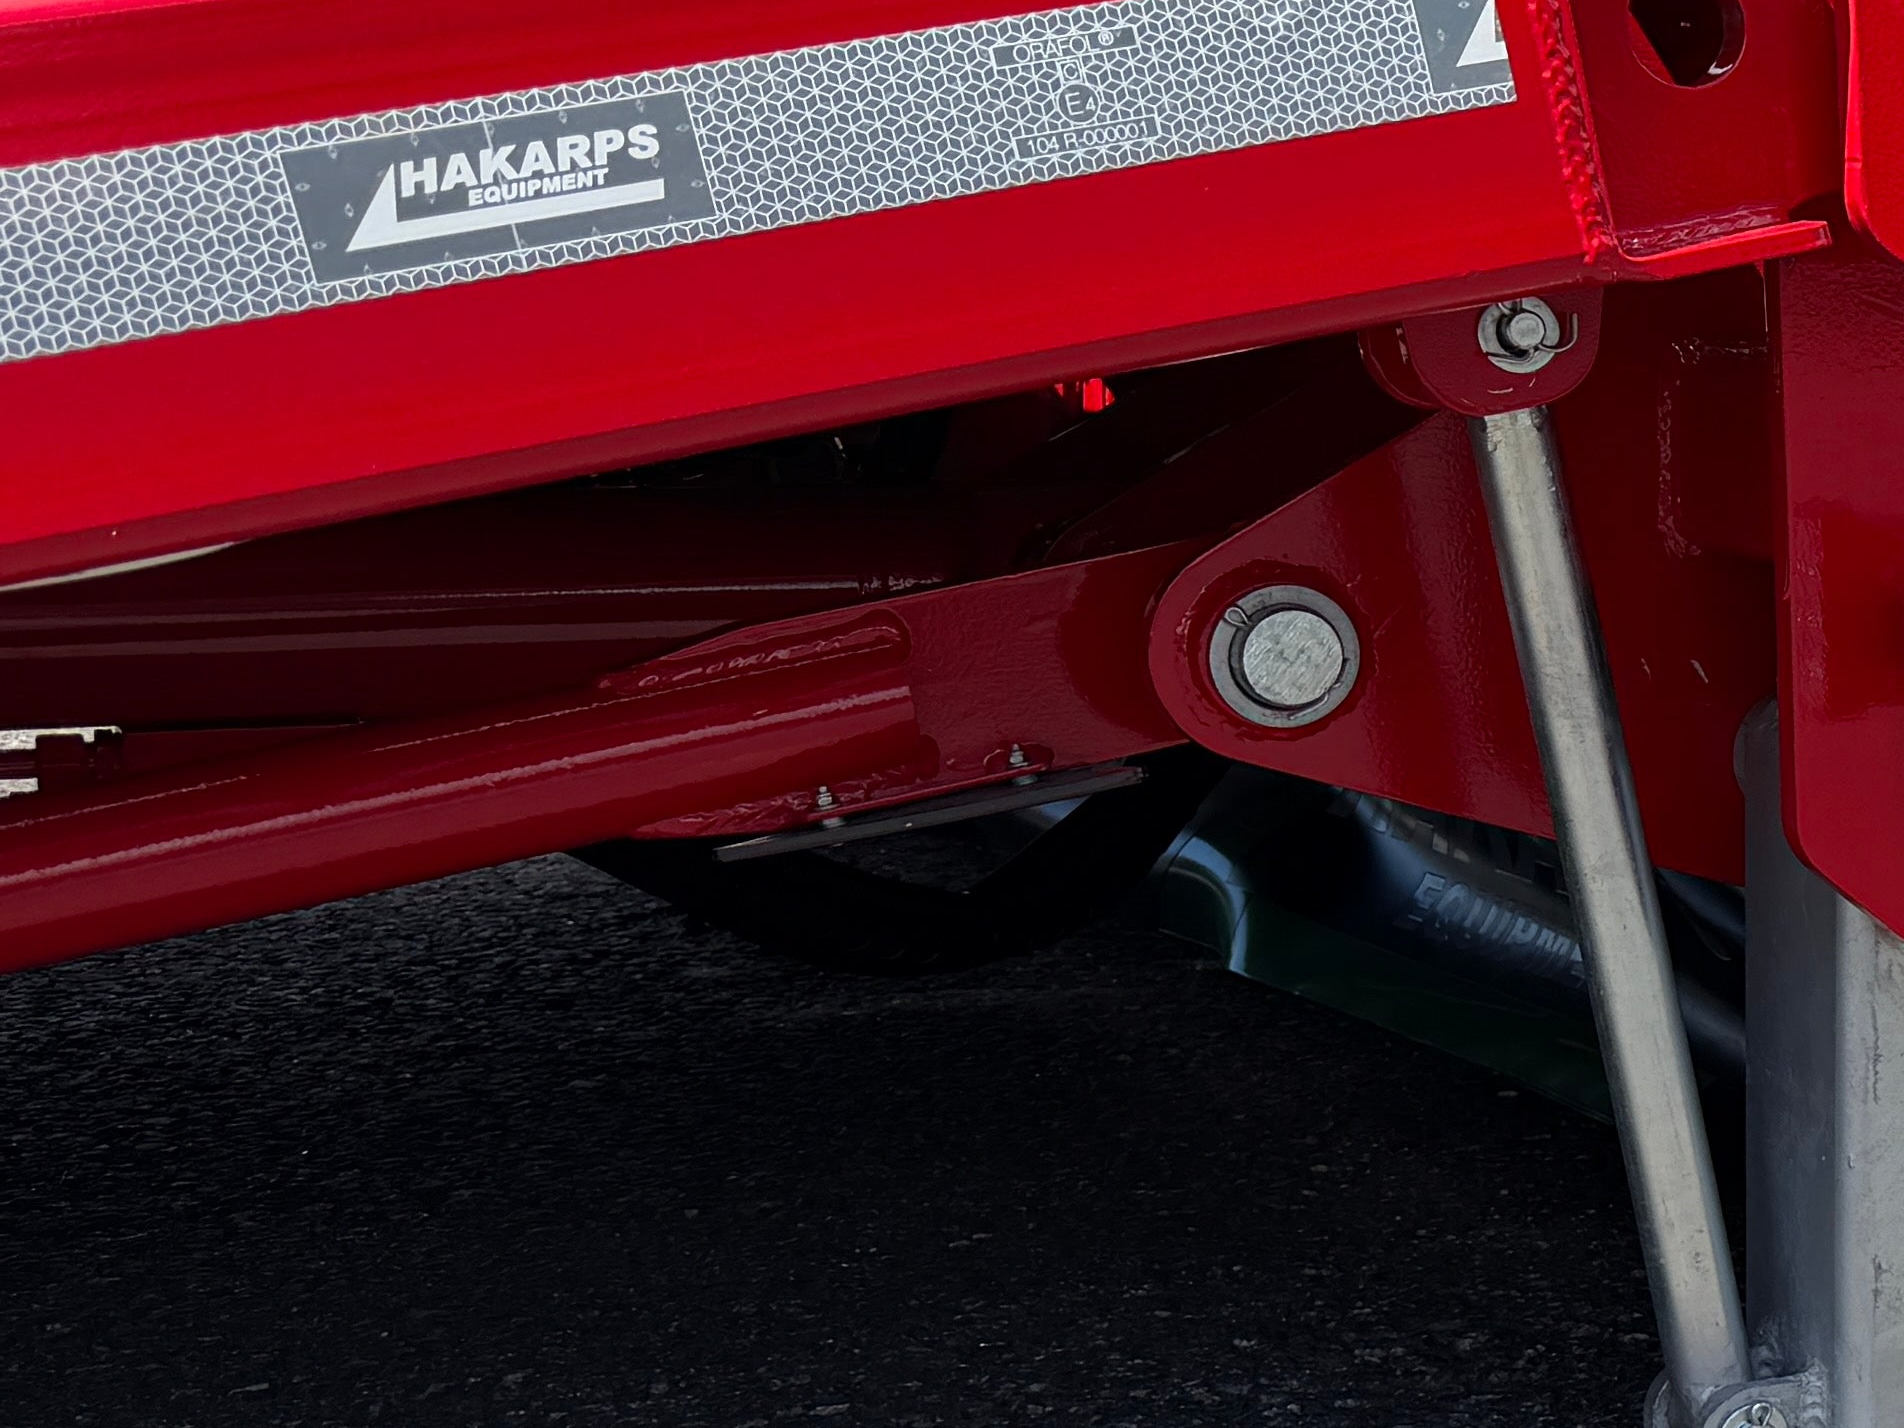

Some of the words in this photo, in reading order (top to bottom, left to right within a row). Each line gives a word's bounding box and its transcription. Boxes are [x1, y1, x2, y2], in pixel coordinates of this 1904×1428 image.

[1027, 135, 1060, 155] 104
[1063, 119, 1149, 149] R-000001
[398, 123, 660, 198] HAKARPS
[468, 167, 609, 208] EQUIPMENT
